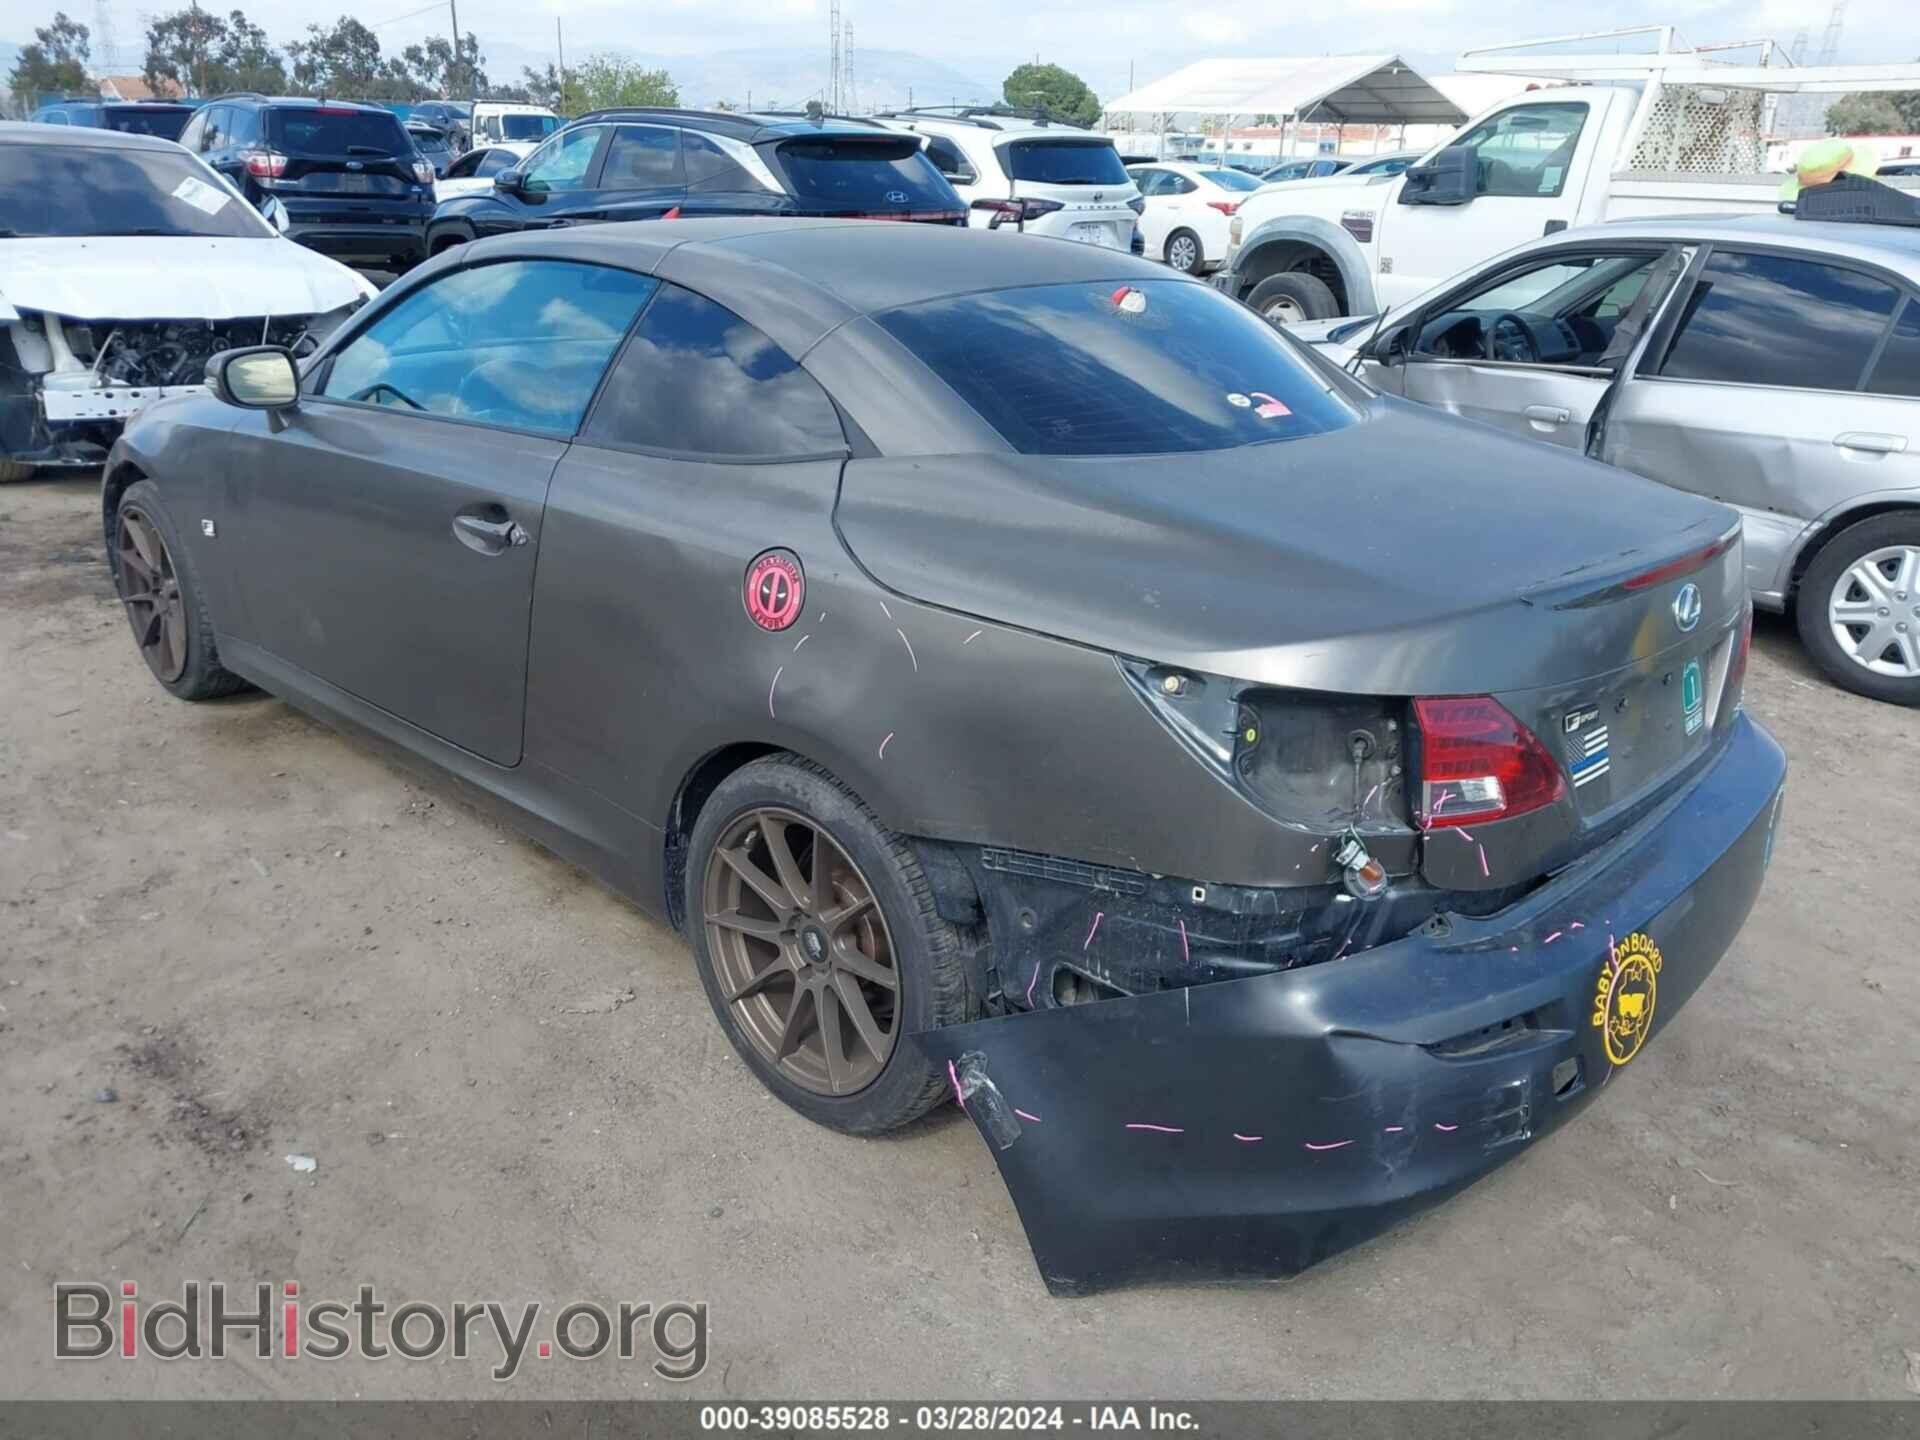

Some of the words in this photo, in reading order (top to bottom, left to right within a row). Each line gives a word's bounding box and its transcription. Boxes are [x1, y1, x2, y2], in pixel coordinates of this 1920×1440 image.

[1592, 961, 1613, 1026] BABY
[1612, 938, 1630, 965] ON
[1631, 932, 1663, 973] BOARD
